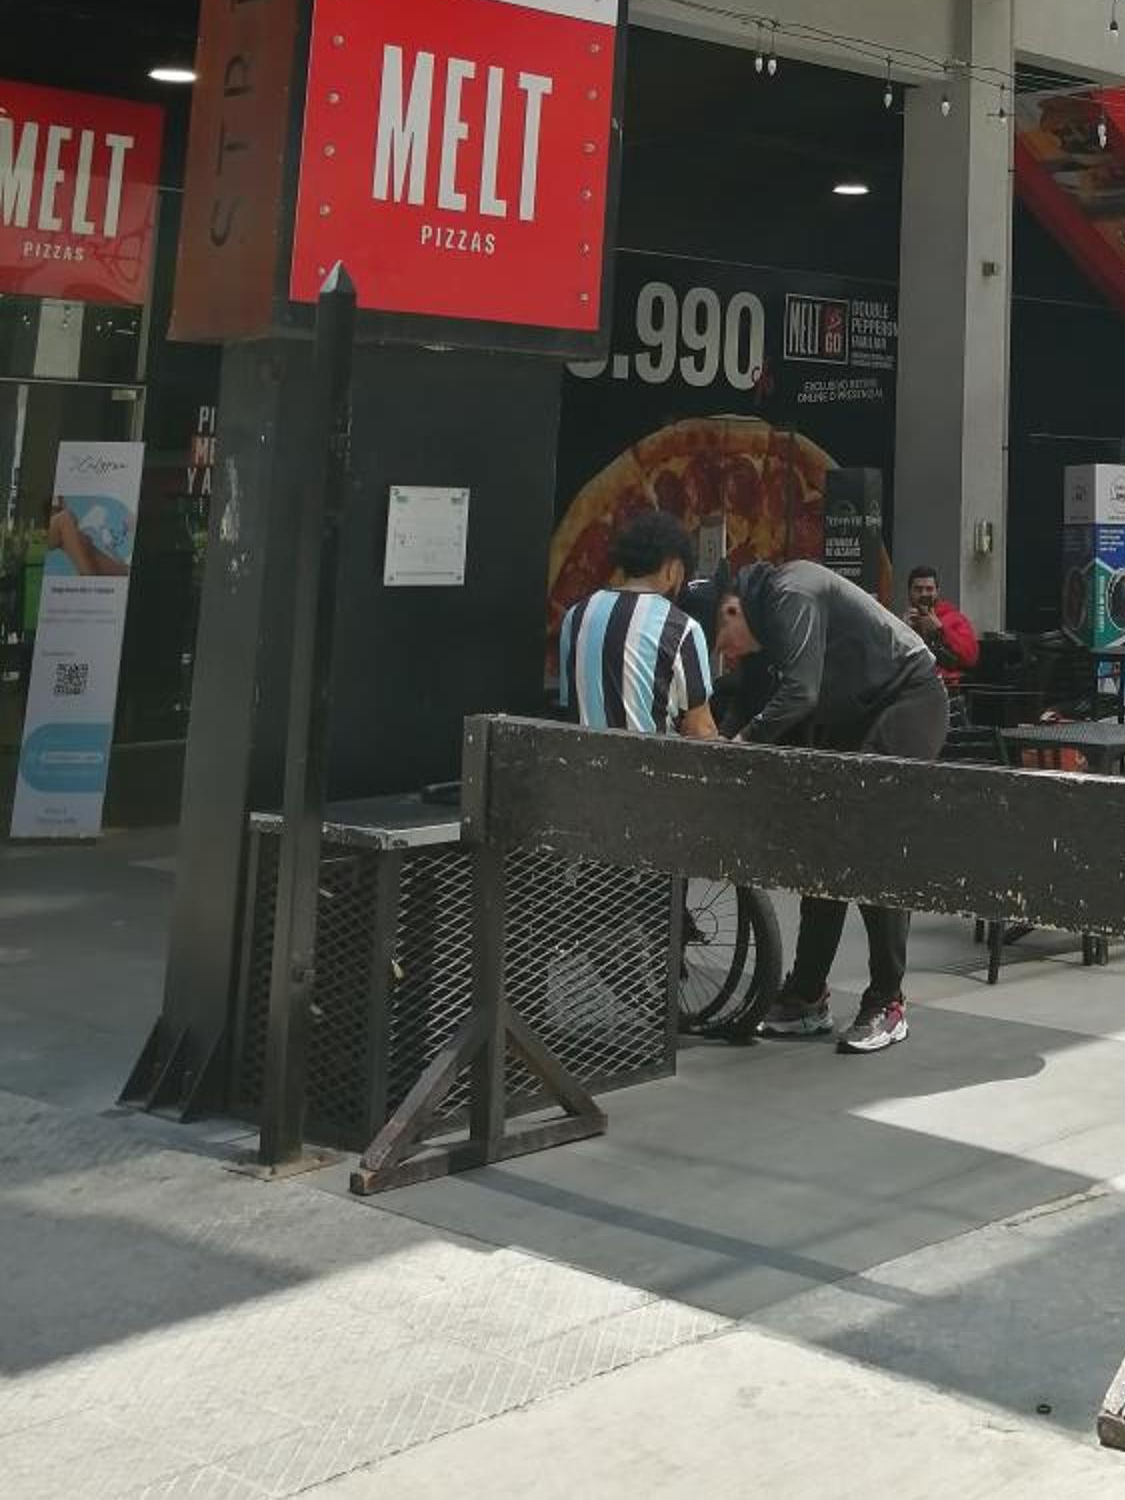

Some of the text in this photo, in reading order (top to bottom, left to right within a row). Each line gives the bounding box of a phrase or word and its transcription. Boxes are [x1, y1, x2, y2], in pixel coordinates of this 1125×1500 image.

[0, 114, 135, 240] MELT
[372, 43, 554, 222] MELT
[23, 240, 85, 262] PIZZAS
[420, 224, 496, 256] PIZZAS
[564, 280, 766, 391] .990
